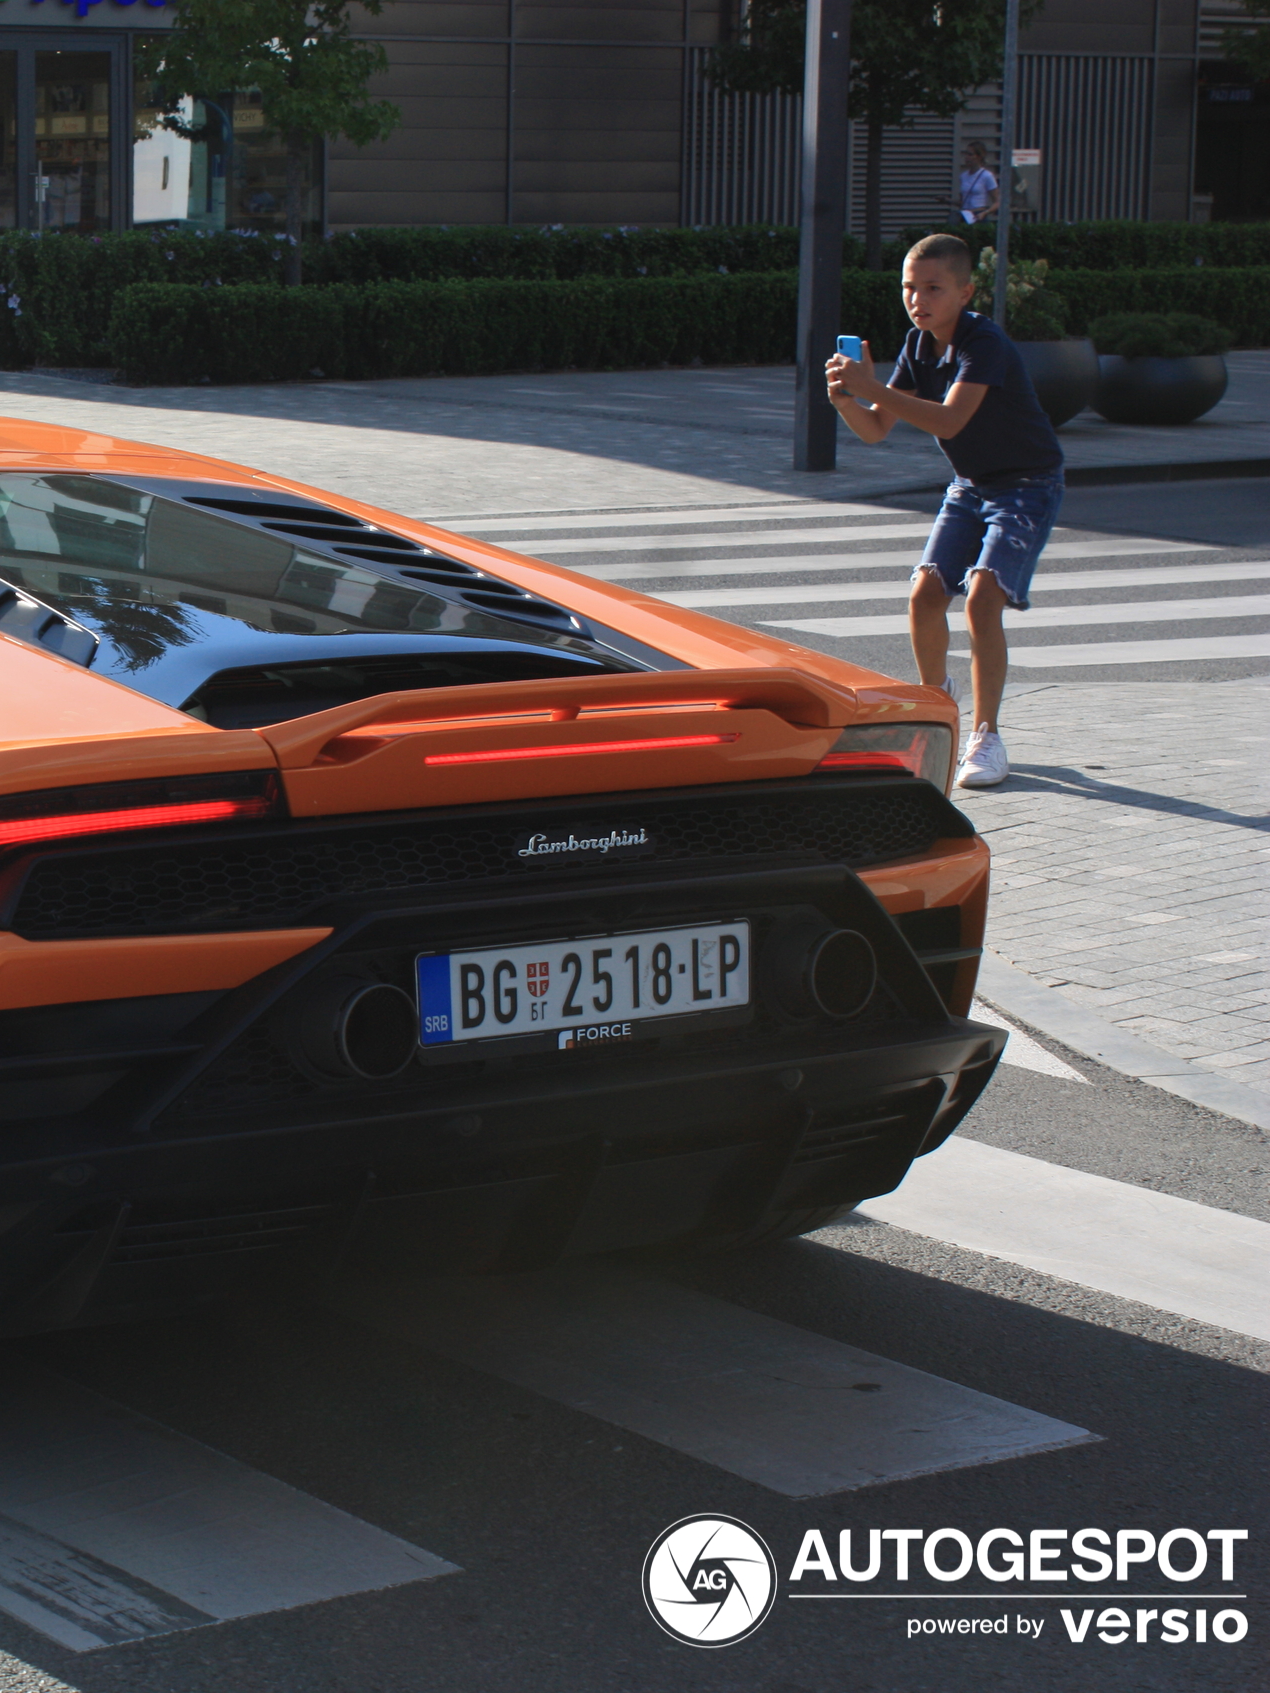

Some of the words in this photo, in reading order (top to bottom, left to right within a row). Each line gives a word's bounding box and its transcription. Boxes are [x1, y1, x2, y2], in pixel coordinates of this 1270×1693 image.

[234, 112, 257, 123] VICHY
[517, 827, 649, 857] Lamborghini
[461, 958, 519, 1031] BG
[424, 1015, 449, 1033] SRB
[576, 1022, 632, 1041] FORCE
